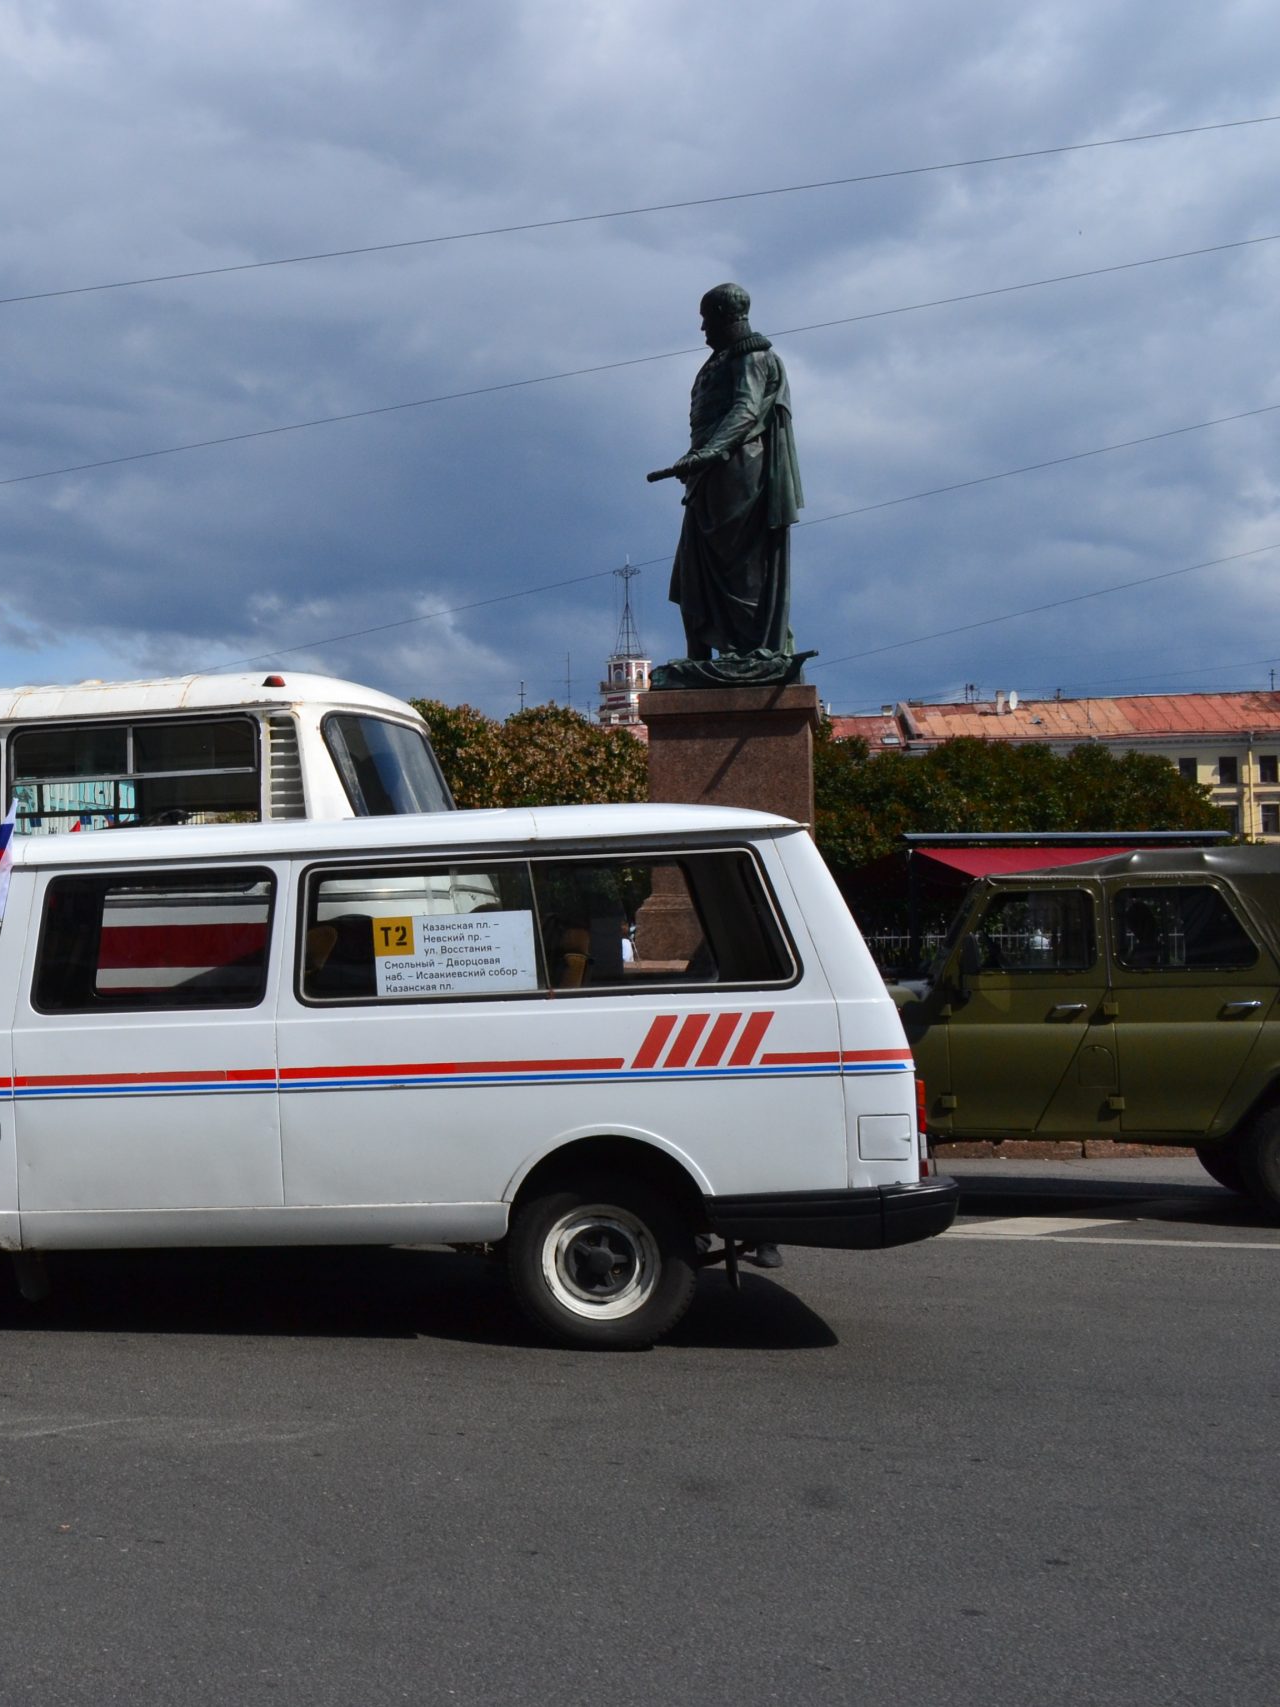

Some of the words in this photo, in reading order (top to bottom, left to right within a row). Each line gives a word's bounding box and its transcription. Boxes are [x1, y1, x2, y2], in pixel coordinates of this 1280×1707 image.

[422, 922, 474, 932] Казанская
[423, 933, 465, 944] Невский
[468, 934, 482, 942] пр.
[424, 947, 438, 956] ул.
[440, 945, 492, 954] Восстания
[384, 960, 435, 970] Смольный
[446, 957, 501, 968] Дворцовая
[385, 972, 406, 981] наб.
[416, 968, 486, 980] Исаакиевский
[488, 967, 518, 977] собор
[385, 984, 437, 993] Казанская
[439, 983, 454, 991] пл.
